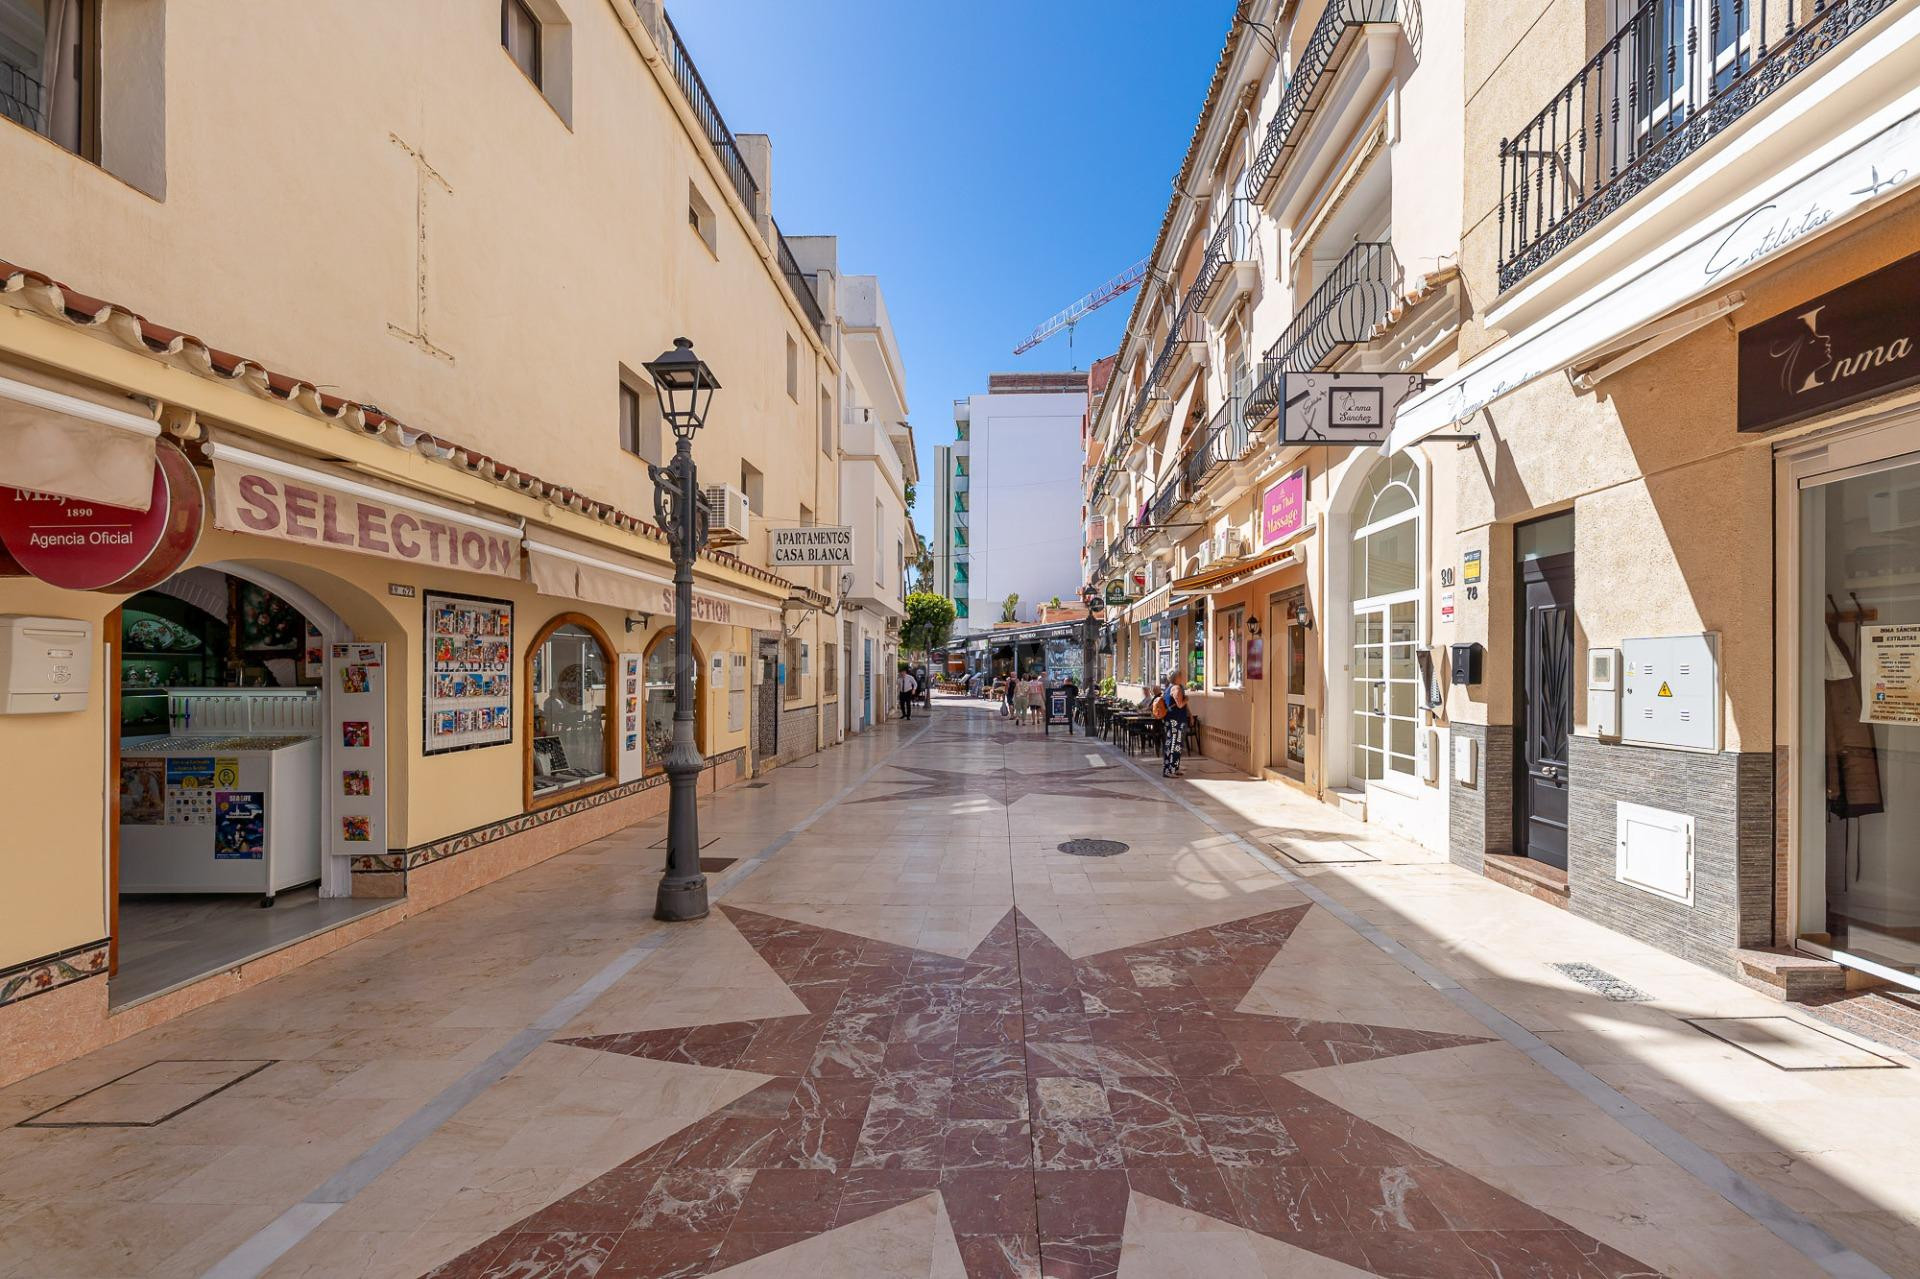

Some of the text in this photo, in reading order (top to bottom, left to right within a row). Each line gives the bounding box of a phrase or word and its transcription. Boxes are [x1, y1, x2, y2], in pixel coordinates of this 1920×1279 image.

[66, 508, 93, 517] 1890
[237, 474, 511, 573] SELECTION
[1266, 509, 1298, 534] Massage
[30, 531, 133, 549] Agencia Oficial
[776, 531, 850, 545] APARTAMENTOS
[776, 548, 850, 562] CASA BLANCA
[1466, 586, 1478, 600] 78
[663, 588, 731, 623] SECTION
